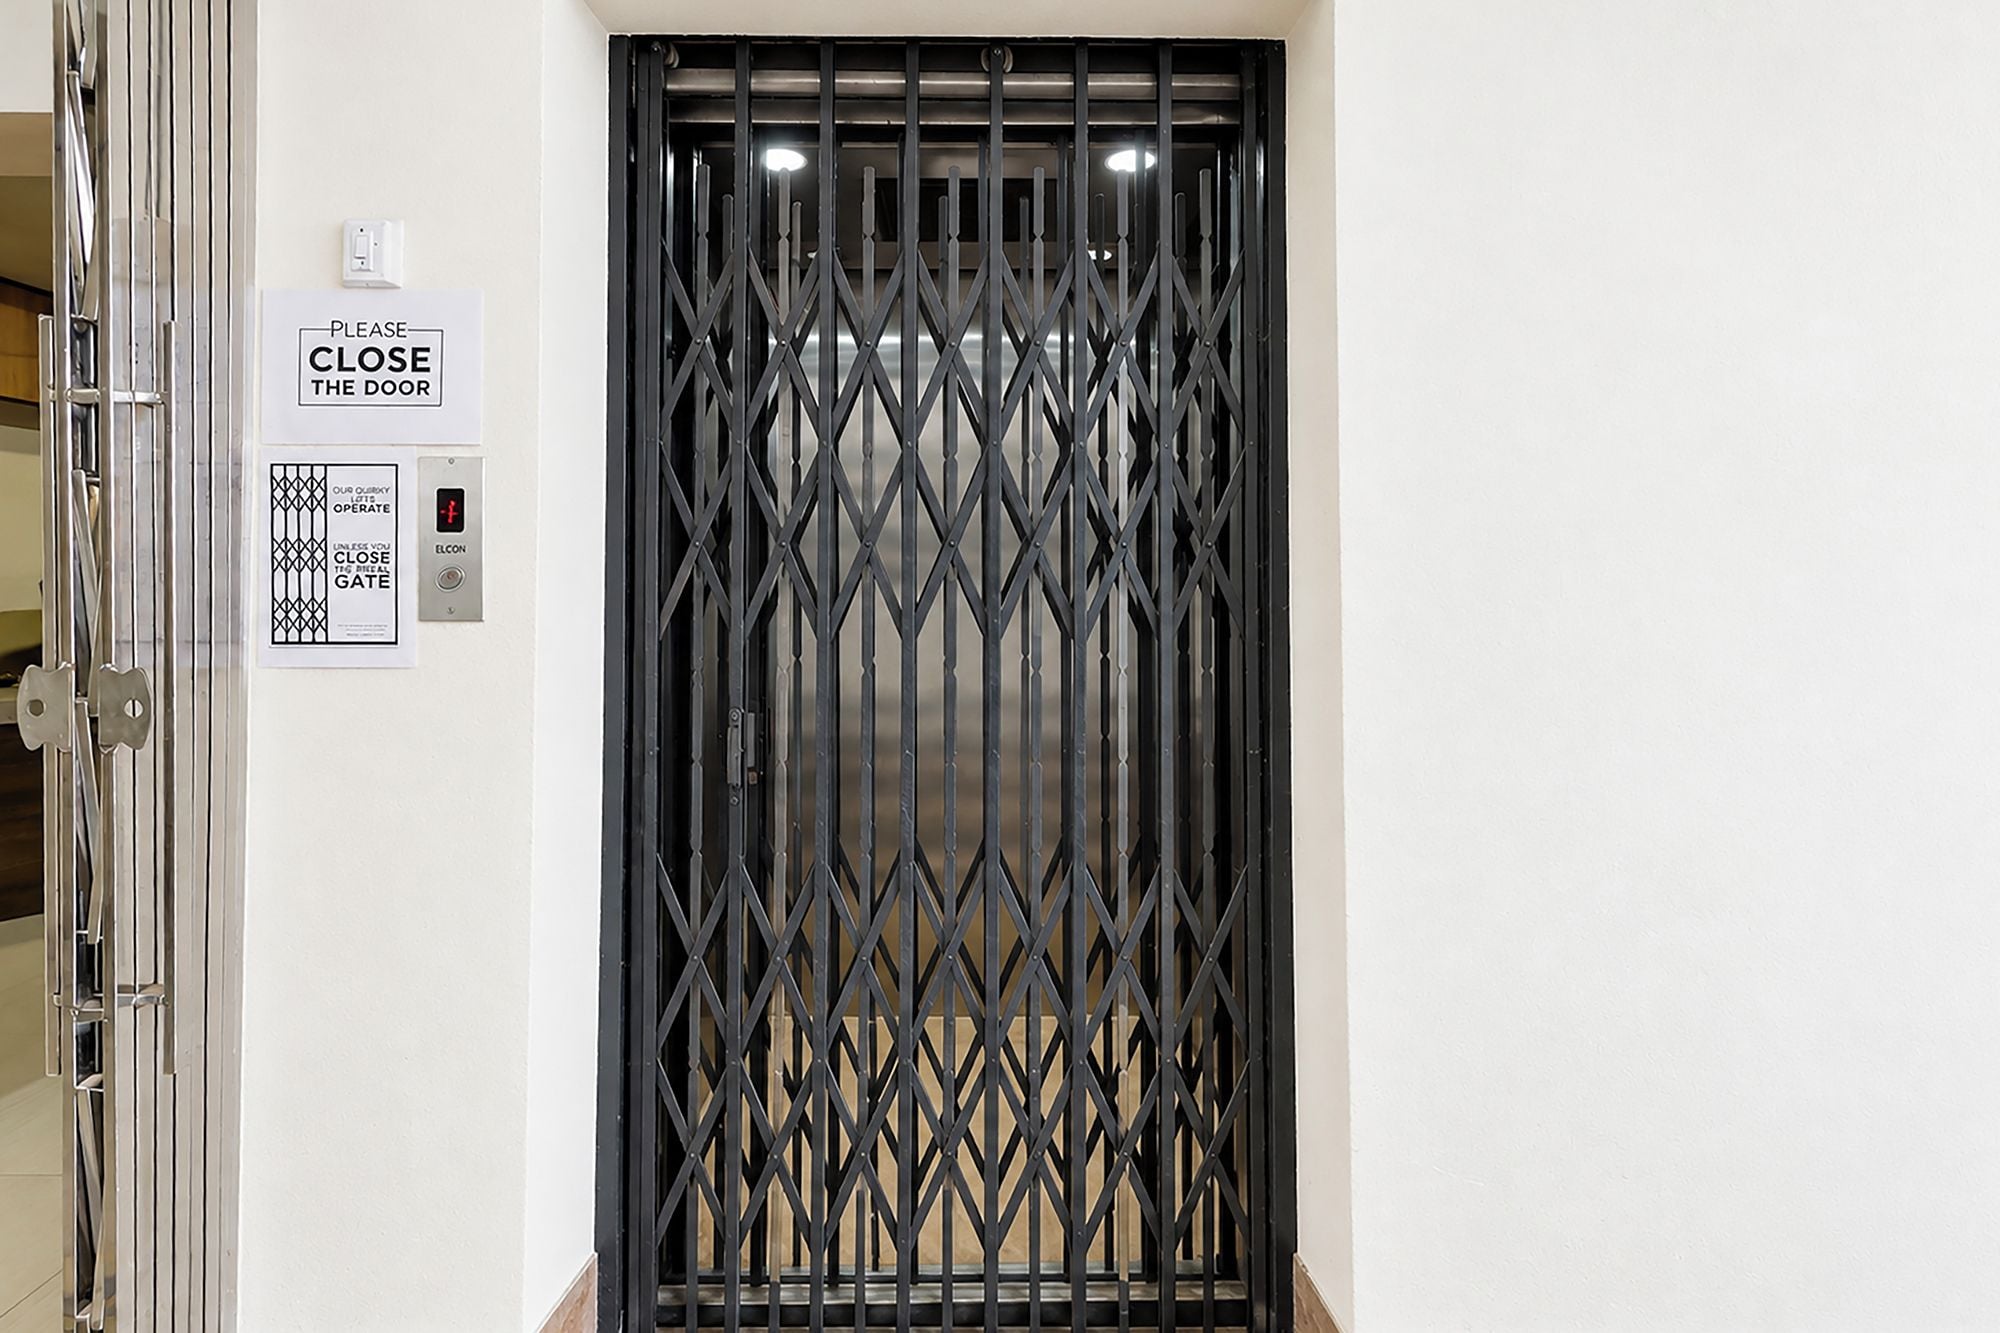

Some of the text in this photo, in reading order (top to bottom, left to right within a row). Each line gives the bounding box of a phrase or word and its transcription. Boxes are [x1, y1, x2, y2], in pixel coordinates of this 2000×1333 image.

[331, 320, 407, 338] PLEASE
[308, 346, 430, 373] CLOSE
[311, 380, 430, 396] THE DOOR
[333, 486, 353, 494] OUR
[333, 503, 391, 513] OPERATE
[370, 543, 391, 551] YOU
[436, 545, 466, 554] ELCON
[334, 551, 391, 564] CLOSE
[334, 574, 390, 589] GATE
